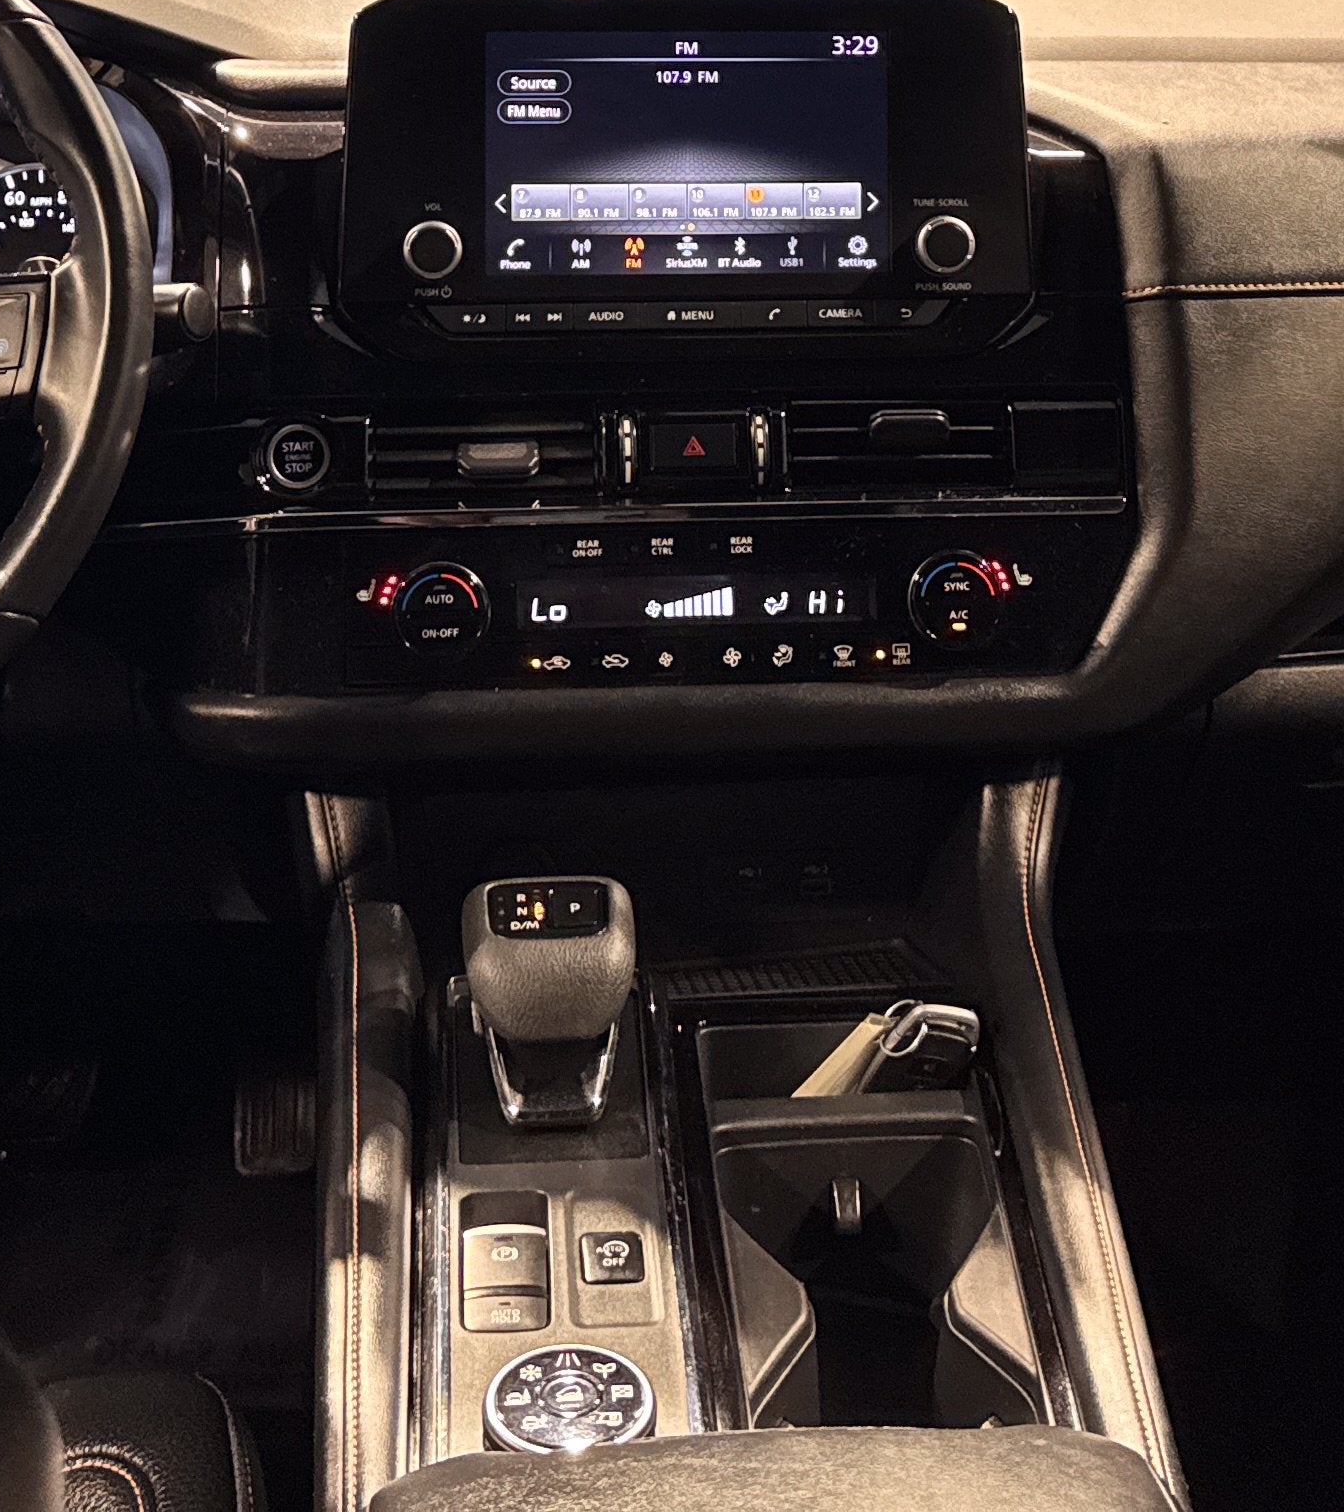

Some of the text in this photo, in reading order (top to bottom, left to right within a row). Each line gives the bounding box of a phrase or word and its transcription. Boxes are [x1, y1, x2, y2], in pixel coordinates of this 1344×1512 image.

[674, 41, 700, 56] FM
[831, 35, 880, 56] 3:29
[655, 70, 720, 84] 107.9 FM
[510, 75, 558, 91] Source
[507, 104, 562, 118] FM Menu
[4, 190, 26, 206] 60
[30, 196, 53, 207] MPH
[423, 203, 443, 212] VOL
[603, 208, 620, 218] FM
[662, 207, 678, 217] FM
[692, 207, 739, 218] 106.1 FM
[750, 207, 798, 217] 107.9 FM
[839, 207, 856, 217] FM
[545, 209, 562, 219] FM
[499, 259, 532, 270] Phone
[571, 258, 591, 269] AM
[625, 258, 642, 269] FM
[665, 257, 708, 268] SiriusXM
[717, 257, 762, 268] BT Audio
[779, 257, 804, 268] USB1
[837, 256, 878, 270] Settings
[942, 281, 972, 291] SOUND
[414, 287, 439, 297] PUSH
[588, 310, 624, 322] AUDIO
[681, 309, 715, 322] MENU
[818, 307, 863, 320] CAMERA
[281, 440, 315, 453] START
[284, 462, 313, 474] STOP
[576, 539, 600, 549] REAR
[651, 537, 674, 547] REAR
[729, 535, 753, 545] REAR
[651, 547, 674, 556] CTRL
[730, 544, 753, 554] LOCK
[943, 581, 971, 592] SYNC
[424, 594, 454, 605] AUTO
[808, 589, 845, 615] Hi
[530, 597, 568, 622] Lo
[949, 609, 969, 620] A/C
[832, 659, 856, 669] FRONT
[892, 657, 911, 666] REAR
[516, 893, 527, 903] R
[516, 906, 528, 917] N
[569, 902, 581, 914] P
[509, 920, 540, 931] D/M
[602, 1257, 626, 1267] OFF
[491, 1308, 521, 1317] AUTO
[491, 1315, 521, 1324] HOLD
